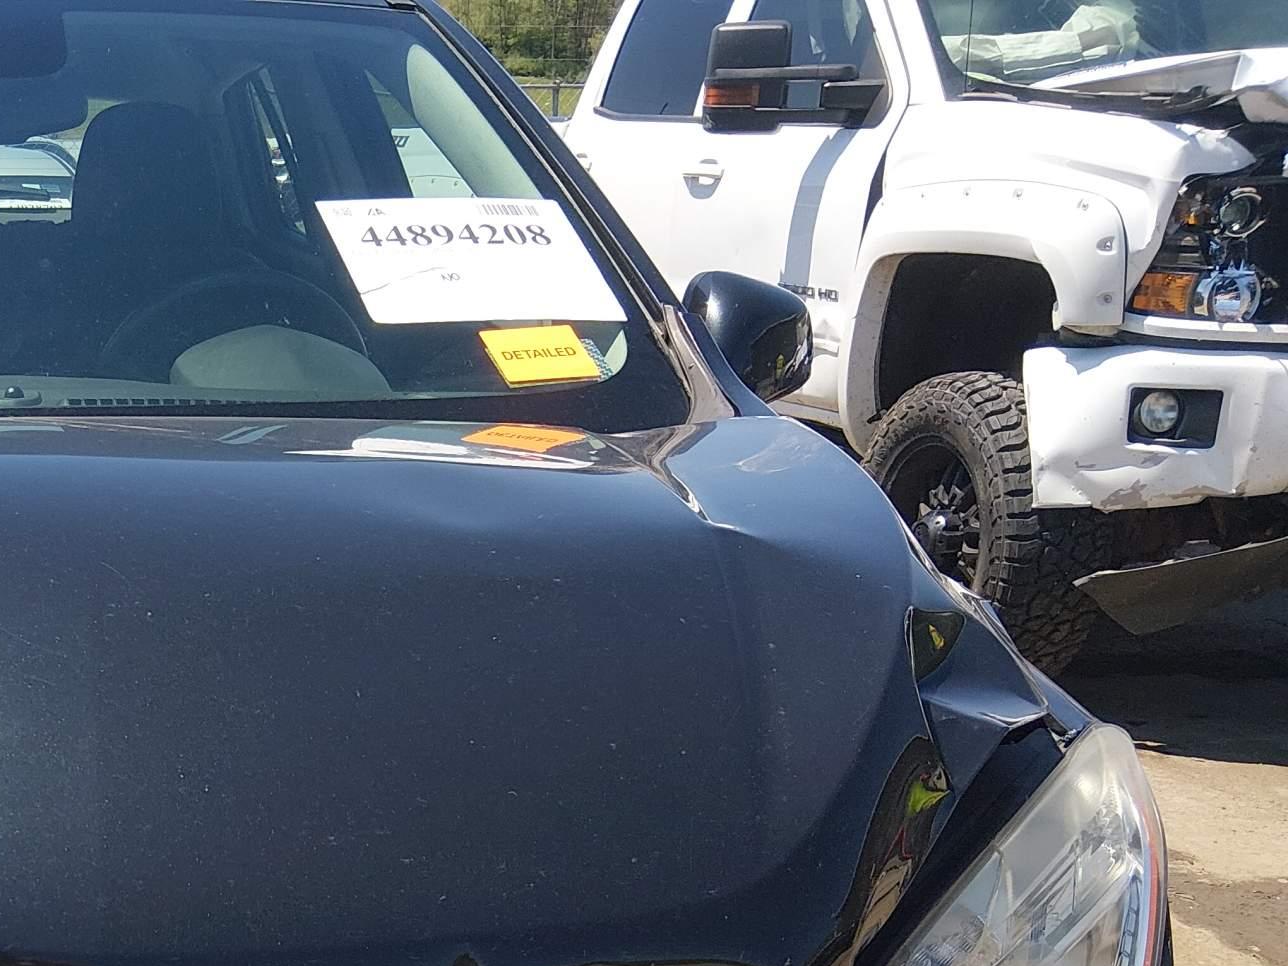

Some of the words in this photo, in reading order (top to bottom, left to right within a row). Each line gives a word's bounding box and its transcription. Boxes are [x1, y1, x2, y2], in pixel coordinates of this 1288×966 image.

[360, 223, 552, 247] 44894208
[818, 287, 839, 302] HD
[501, 346, 577, 361] DETAILED
